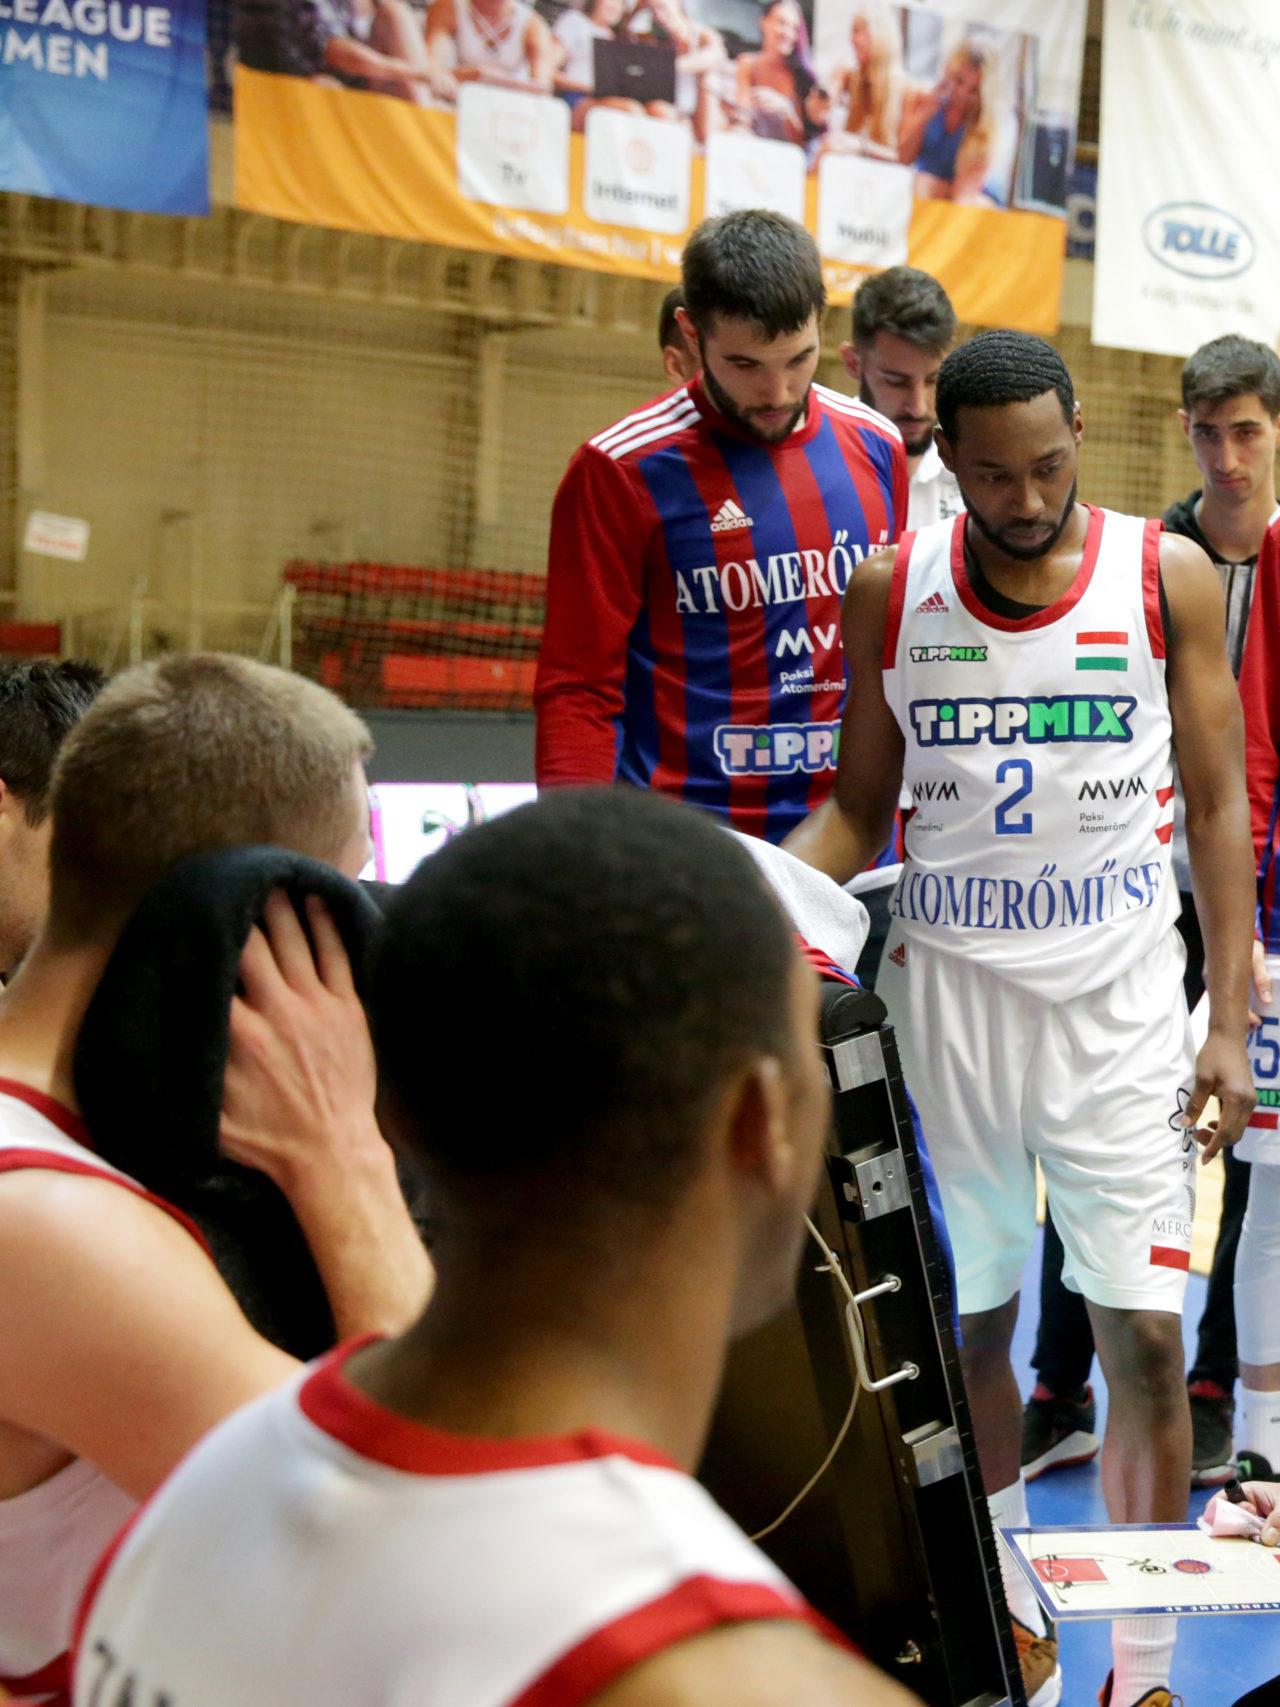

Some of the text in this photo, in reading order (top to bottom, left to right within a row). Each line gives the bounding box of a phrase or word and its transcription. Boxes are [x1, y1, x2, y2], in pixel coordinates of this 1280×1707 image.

[0, 27, 108, 81] MEN
[711, 516, 753, 532] adidas
[676, 530, 888, 614] ATOMERŐ
[916, 606, 949, 614] adidas
[775, 623, 843, 657] MV
[910, 646, 988, 663] TiPPMIX
[780, 665, 814, 683] Paksi
[911, 698, 1134, 745] TiPPMIX
[995, 758, 1034, 835] 2
[1078, 775, 1148, 801] MVM
[1079, 811, 1105, 822] Paksi
